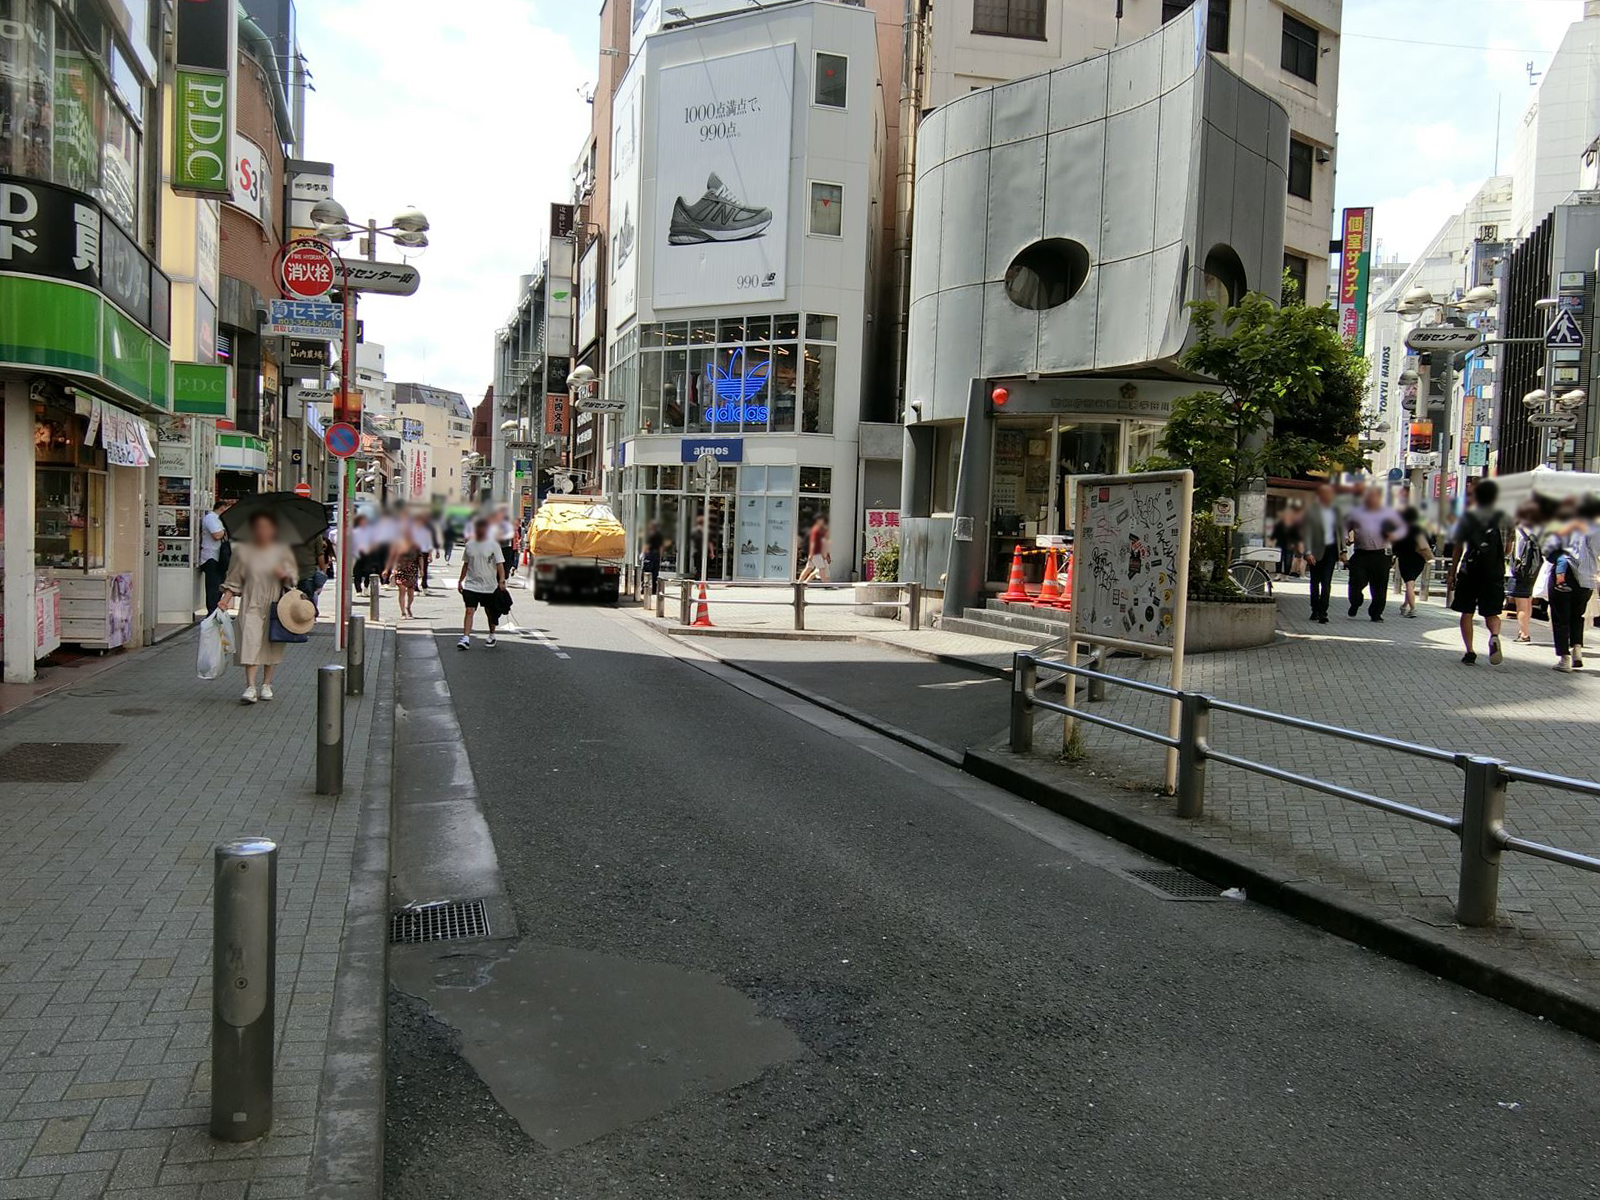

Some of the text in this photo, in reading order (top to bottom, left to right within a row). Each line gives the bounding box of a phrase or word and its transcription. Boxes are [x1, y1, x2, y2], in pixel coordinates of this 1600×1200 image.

[685, 97, 761, 124] 1000点満点で、
[187, 80, 223, 181] P.D.C
[700, 121, 742, 142] 990点。
[1345, 217, 1363, 298] 個室サウナ
[288, 262, 330, 282] 消火栓
[737, 275, 759, 289] 990
[289, 303, 342, 321] セキネ
[1381, 346, 1391, 378] HANDS
[1379, 381, 1389, 412] TOKYU
[705, 402, 770, 423] adidas
[693, 445, 729, 455] atmos
[868, 511, 900, 527] 募集
